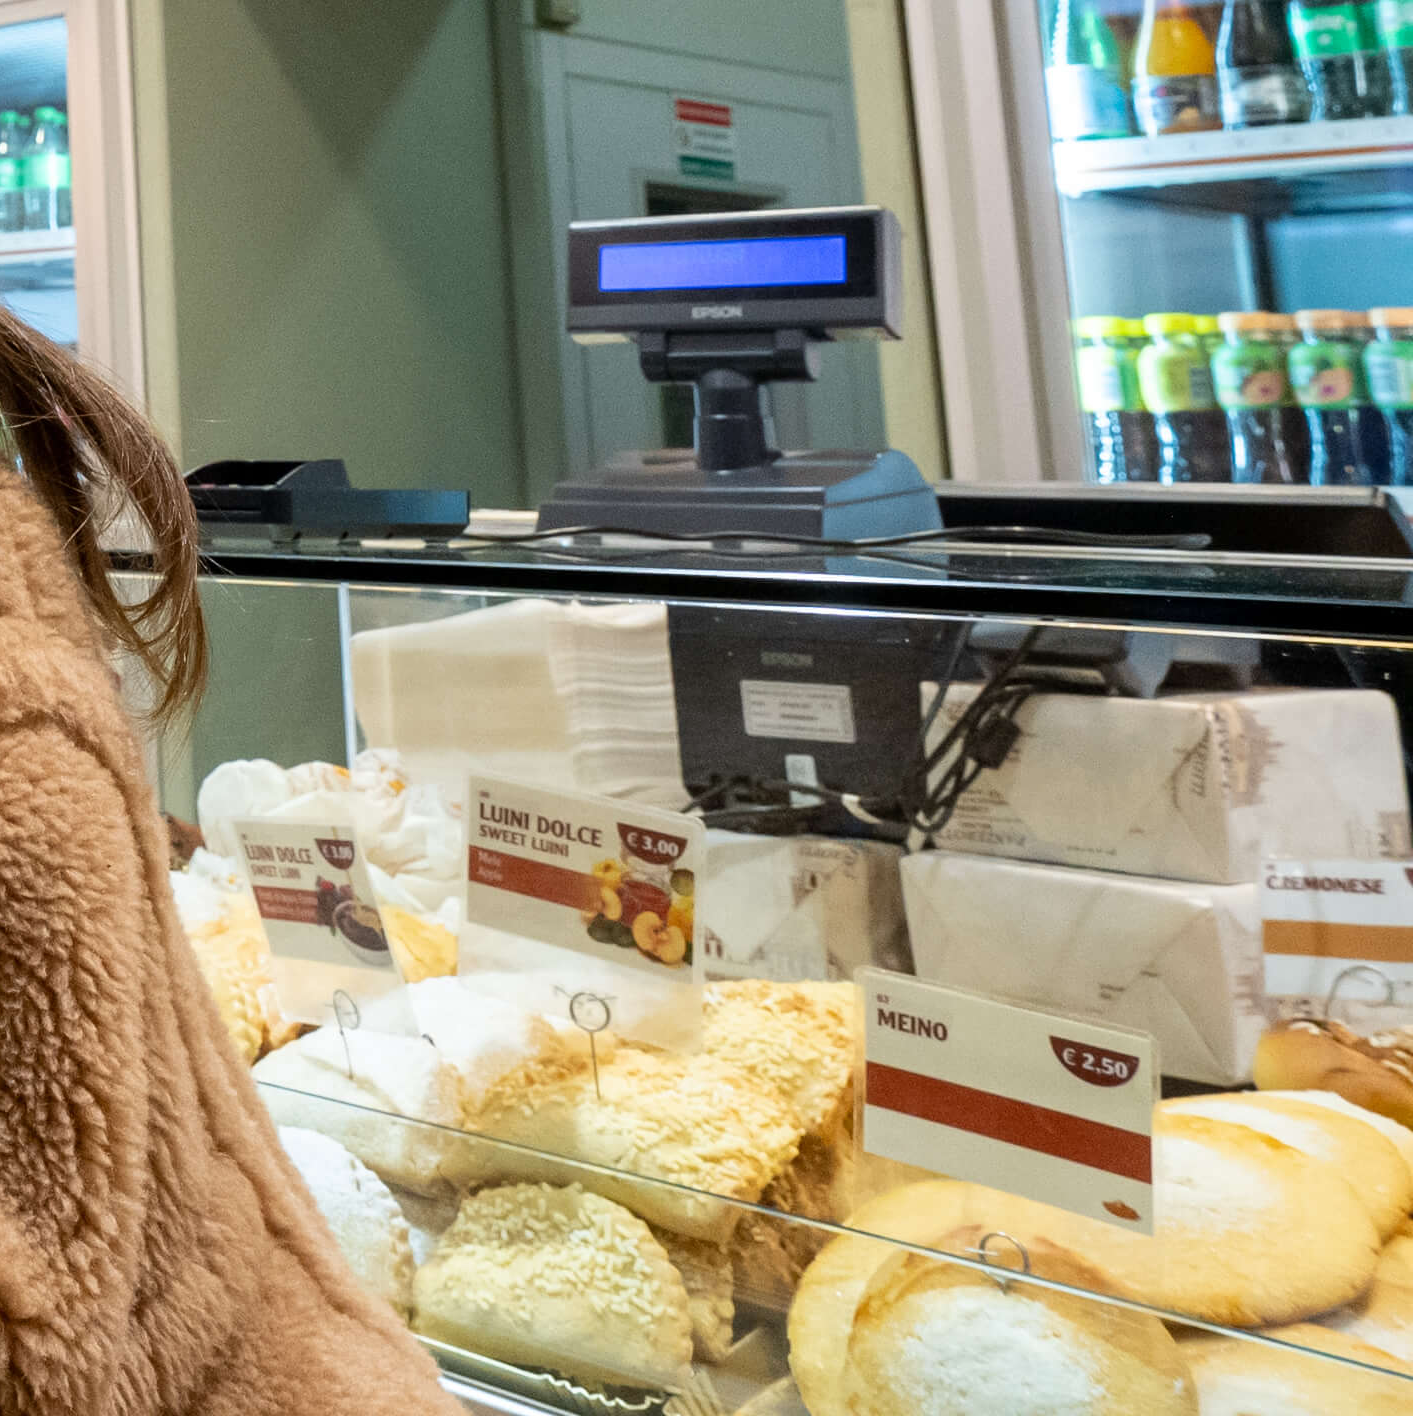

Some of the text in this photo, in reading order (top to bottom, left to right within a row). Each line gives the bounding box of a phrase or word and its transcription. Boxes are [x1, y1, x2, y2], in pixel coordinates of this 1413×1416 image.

[691, 306, 743, 319] EPSON
[479, 802, 603, 848] LUINI DOLCE
[479, 824, 569, 857] SWEET LUINI
[877, 1008, 948, 1042] MEINO
[1062, 1048, 1129, 1079] € 2,50
